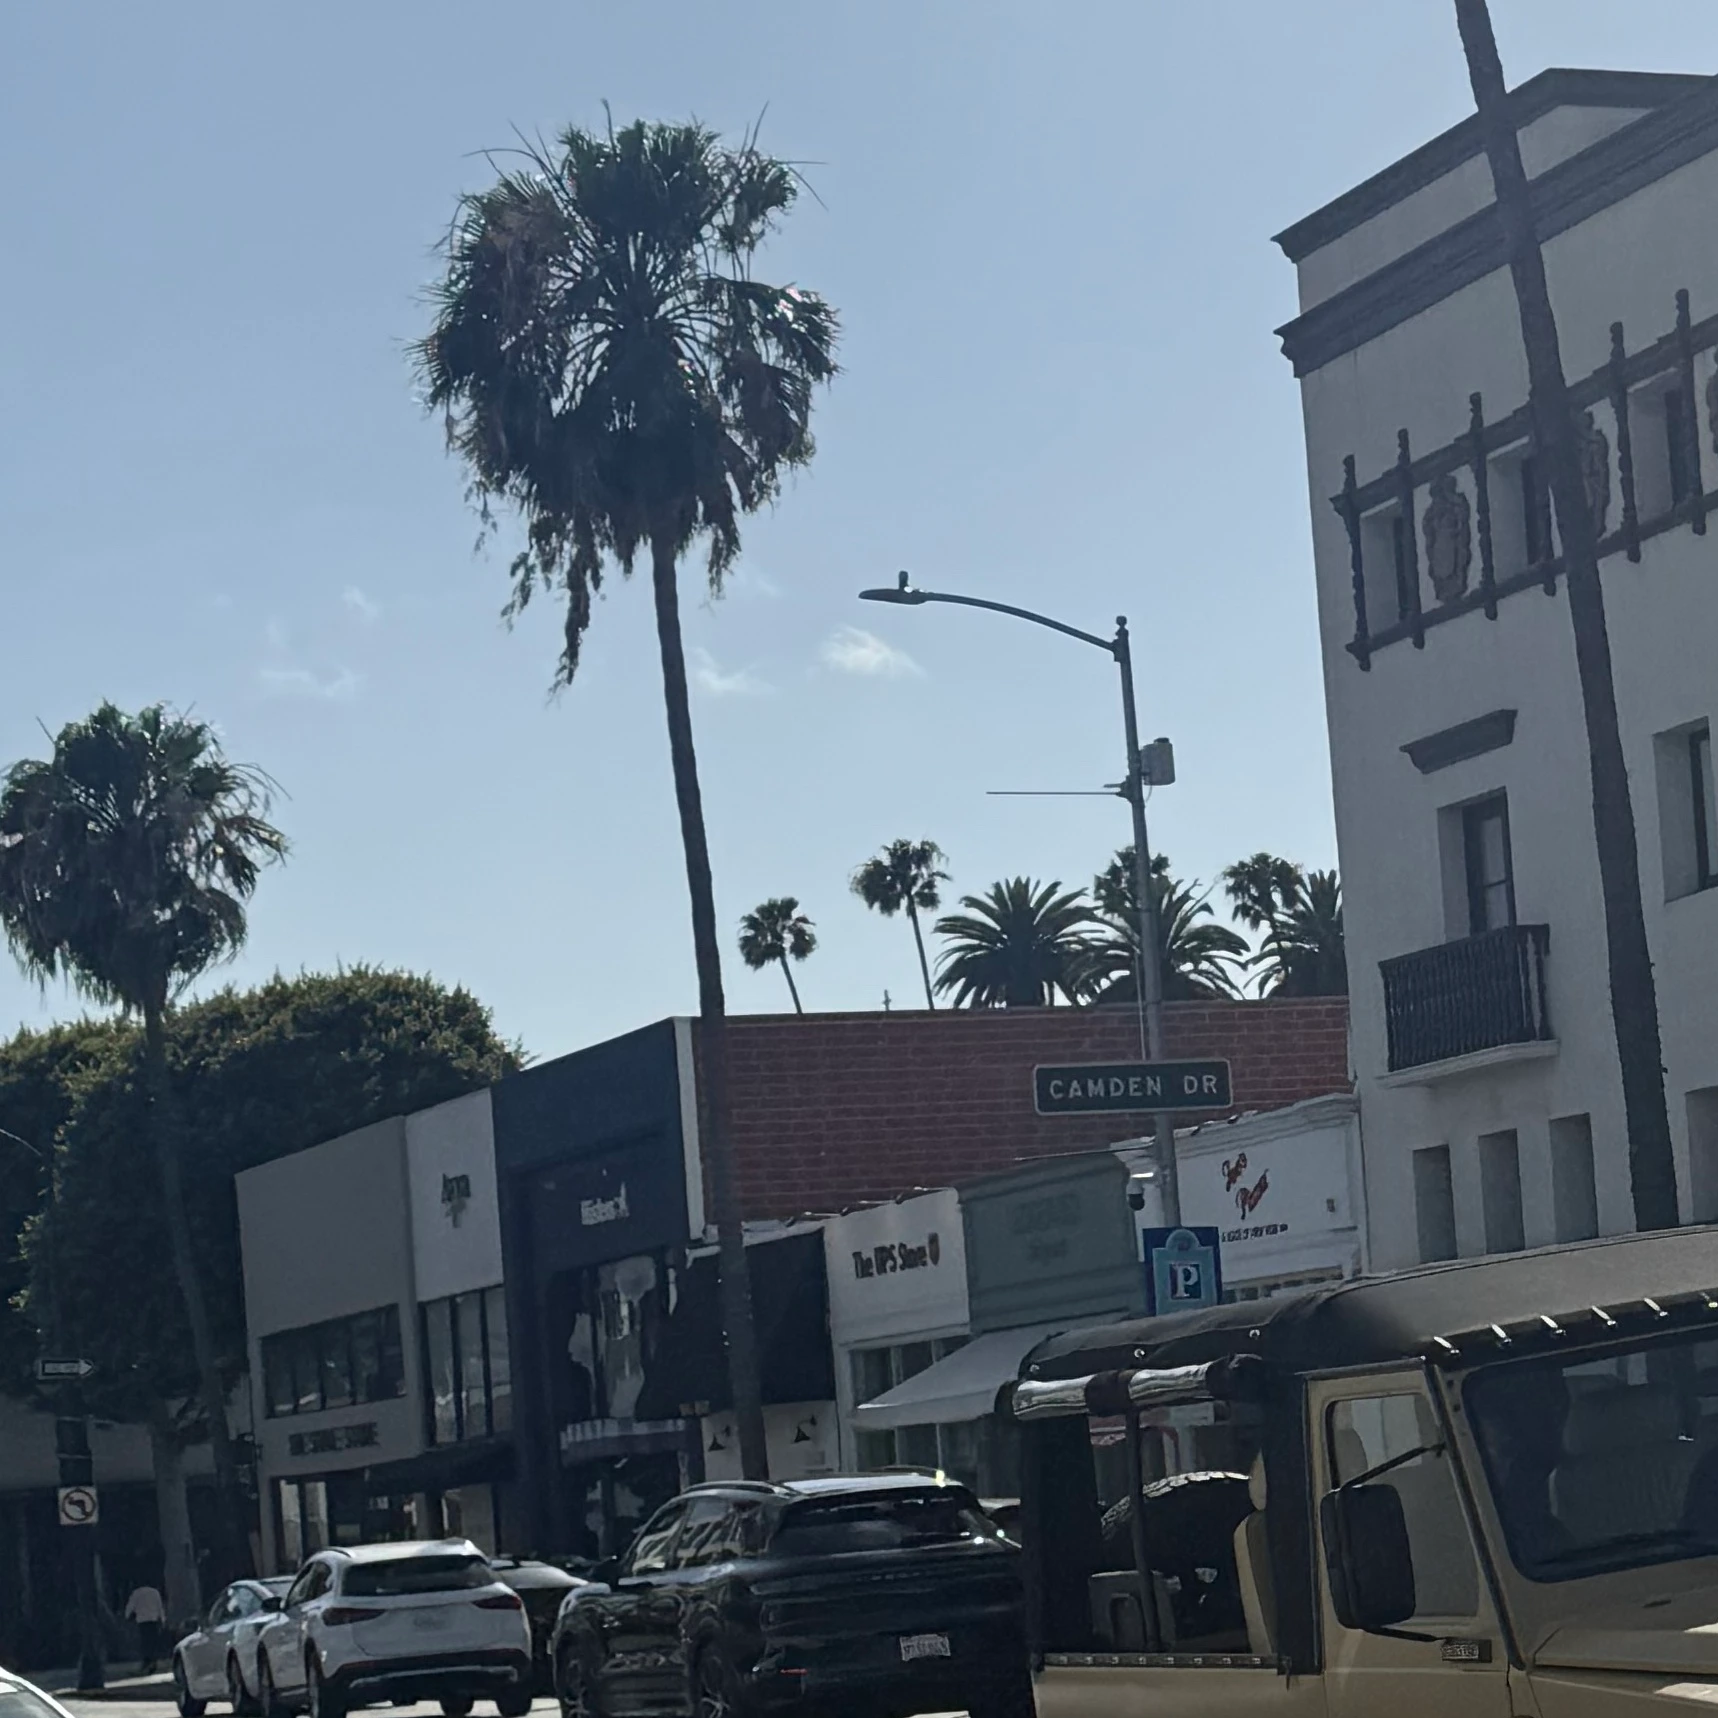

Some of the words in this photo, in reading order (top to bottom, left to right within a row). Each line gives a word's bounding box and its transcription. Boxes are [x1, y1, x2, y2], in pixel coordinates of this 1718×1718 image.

[1049, 1075, 1162, 1100] CAMDEN
[1183, 1074, 1218, 1095] DR
[852, 1251, 874, 1279] The
[874, 1244, 897, 1276] UPS
[1173, 1264, 1198, 1298] P
